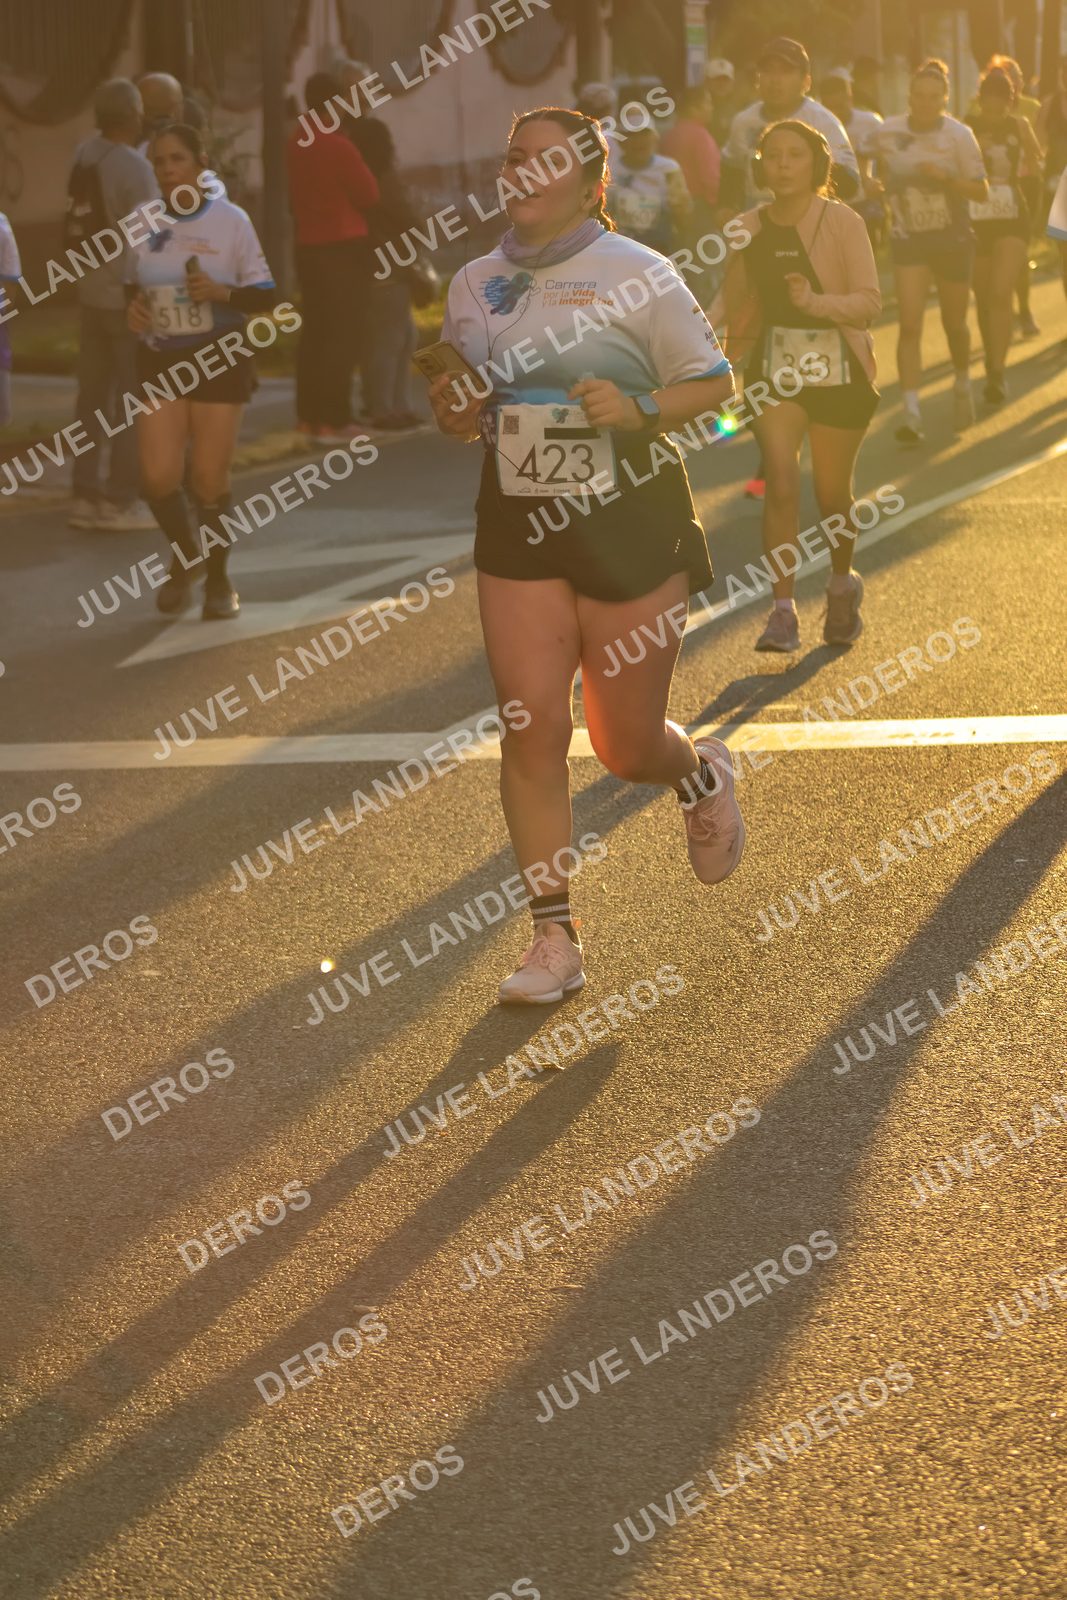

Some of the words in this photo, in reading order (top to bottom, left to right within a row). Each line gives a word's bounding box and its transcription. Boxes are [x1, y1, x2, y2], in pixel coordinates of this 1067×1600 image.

[545, 280, 596, 290] Carrera
[572, 288, 596, 297] Vida
[160, 306, 202, 329] 518
[516, 443, 595, 482] 423
